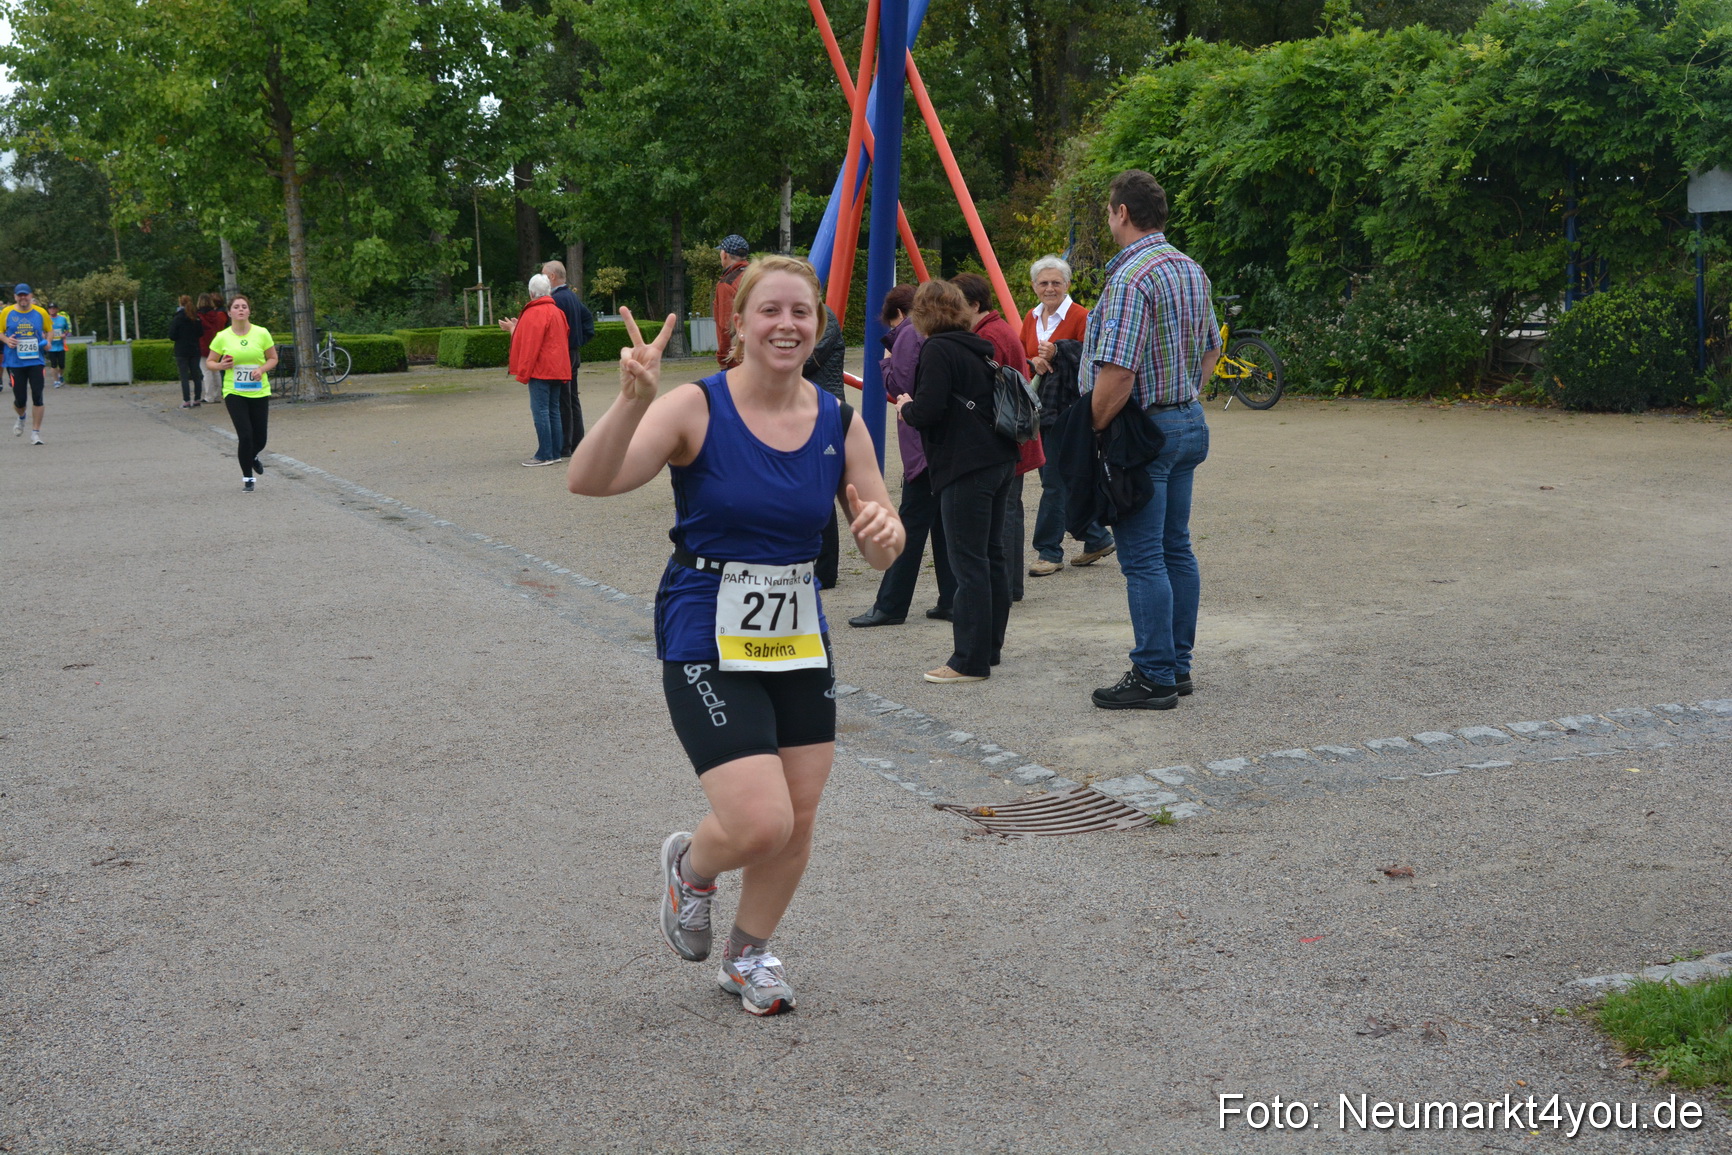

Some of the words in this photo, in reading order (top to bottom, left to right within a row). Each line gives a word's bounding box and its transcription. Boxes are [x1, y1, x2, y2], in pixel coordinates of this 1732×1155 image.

[723, 573, 761, 586] PARTL
[764, 575, 801, 587] Neumakt
[740, 591, 798, 631] 271
[744, 642, 796, 658] Sabrina
[696, 680, 727, 727] odlo
